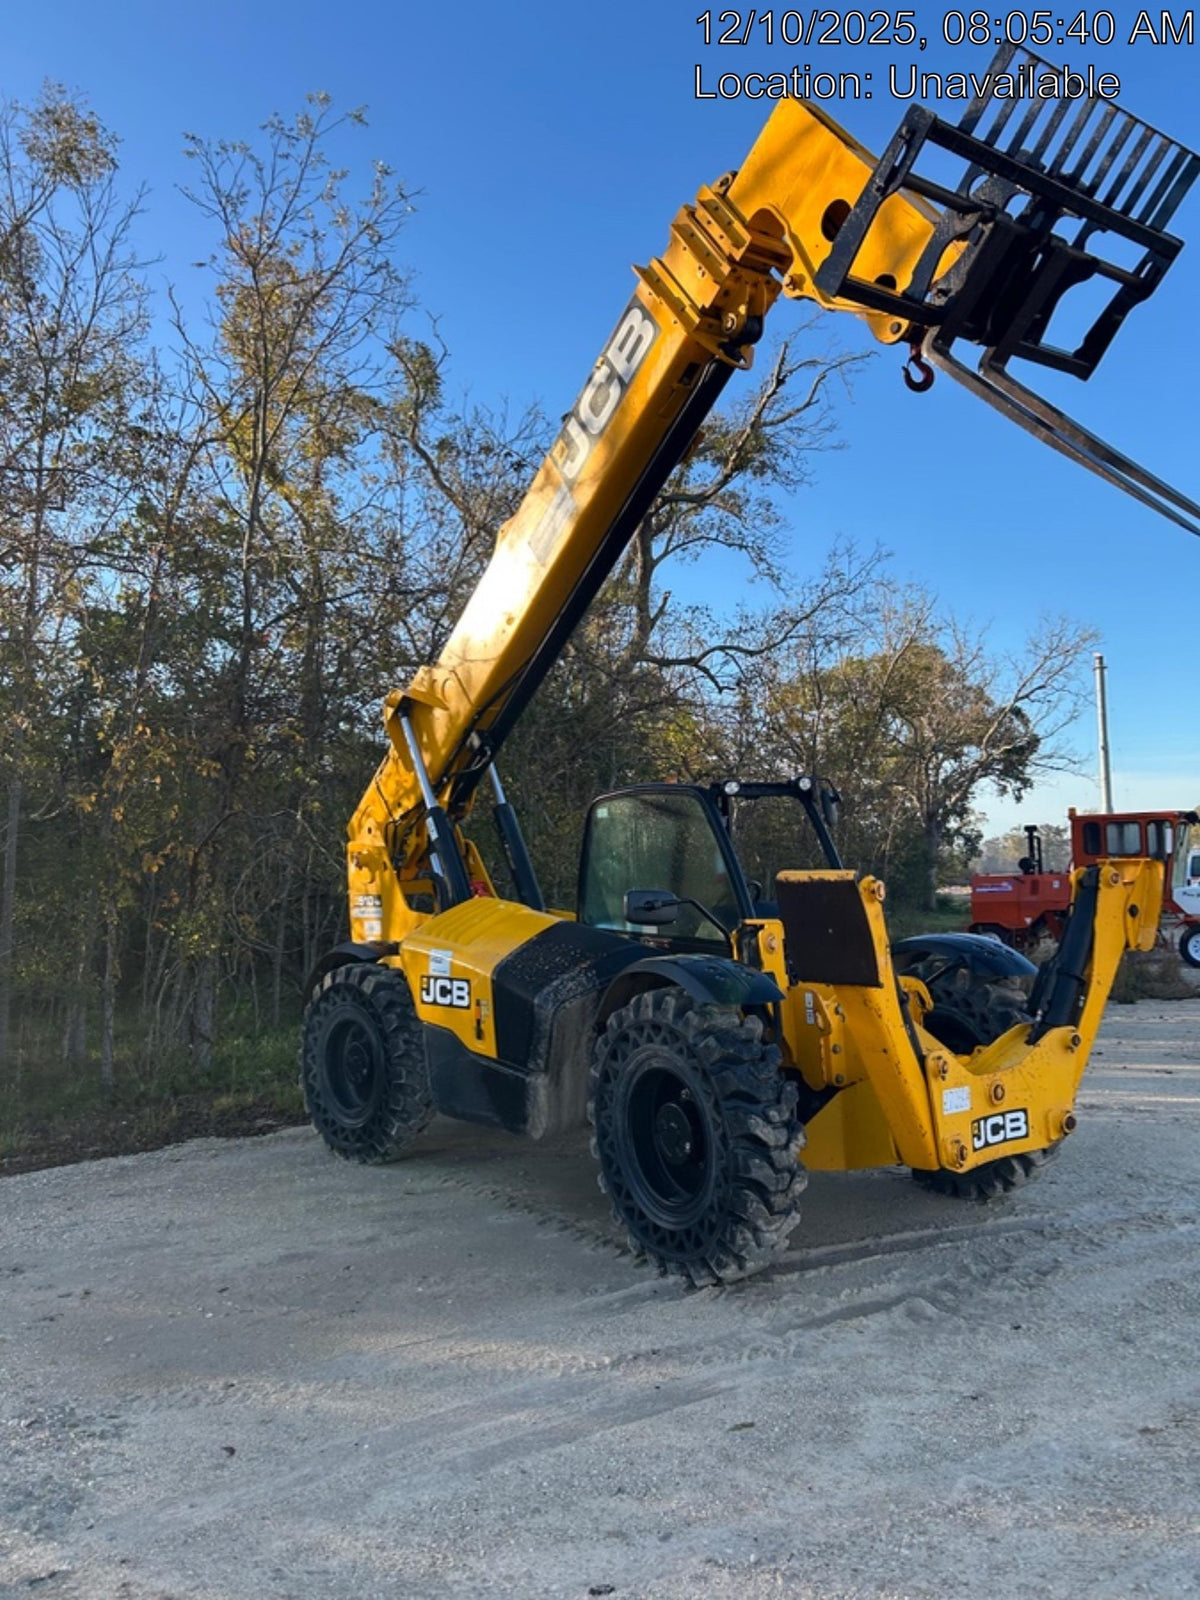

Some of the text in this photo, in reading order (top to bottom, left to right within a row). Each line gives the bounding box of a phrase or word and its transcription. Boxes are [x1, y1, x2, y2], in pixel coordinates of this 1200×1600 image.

[562, 307, 655, 479] JCB
[422, 978, 470, 1007] JCB
[973, 1111, 1027, 1150] JCB
